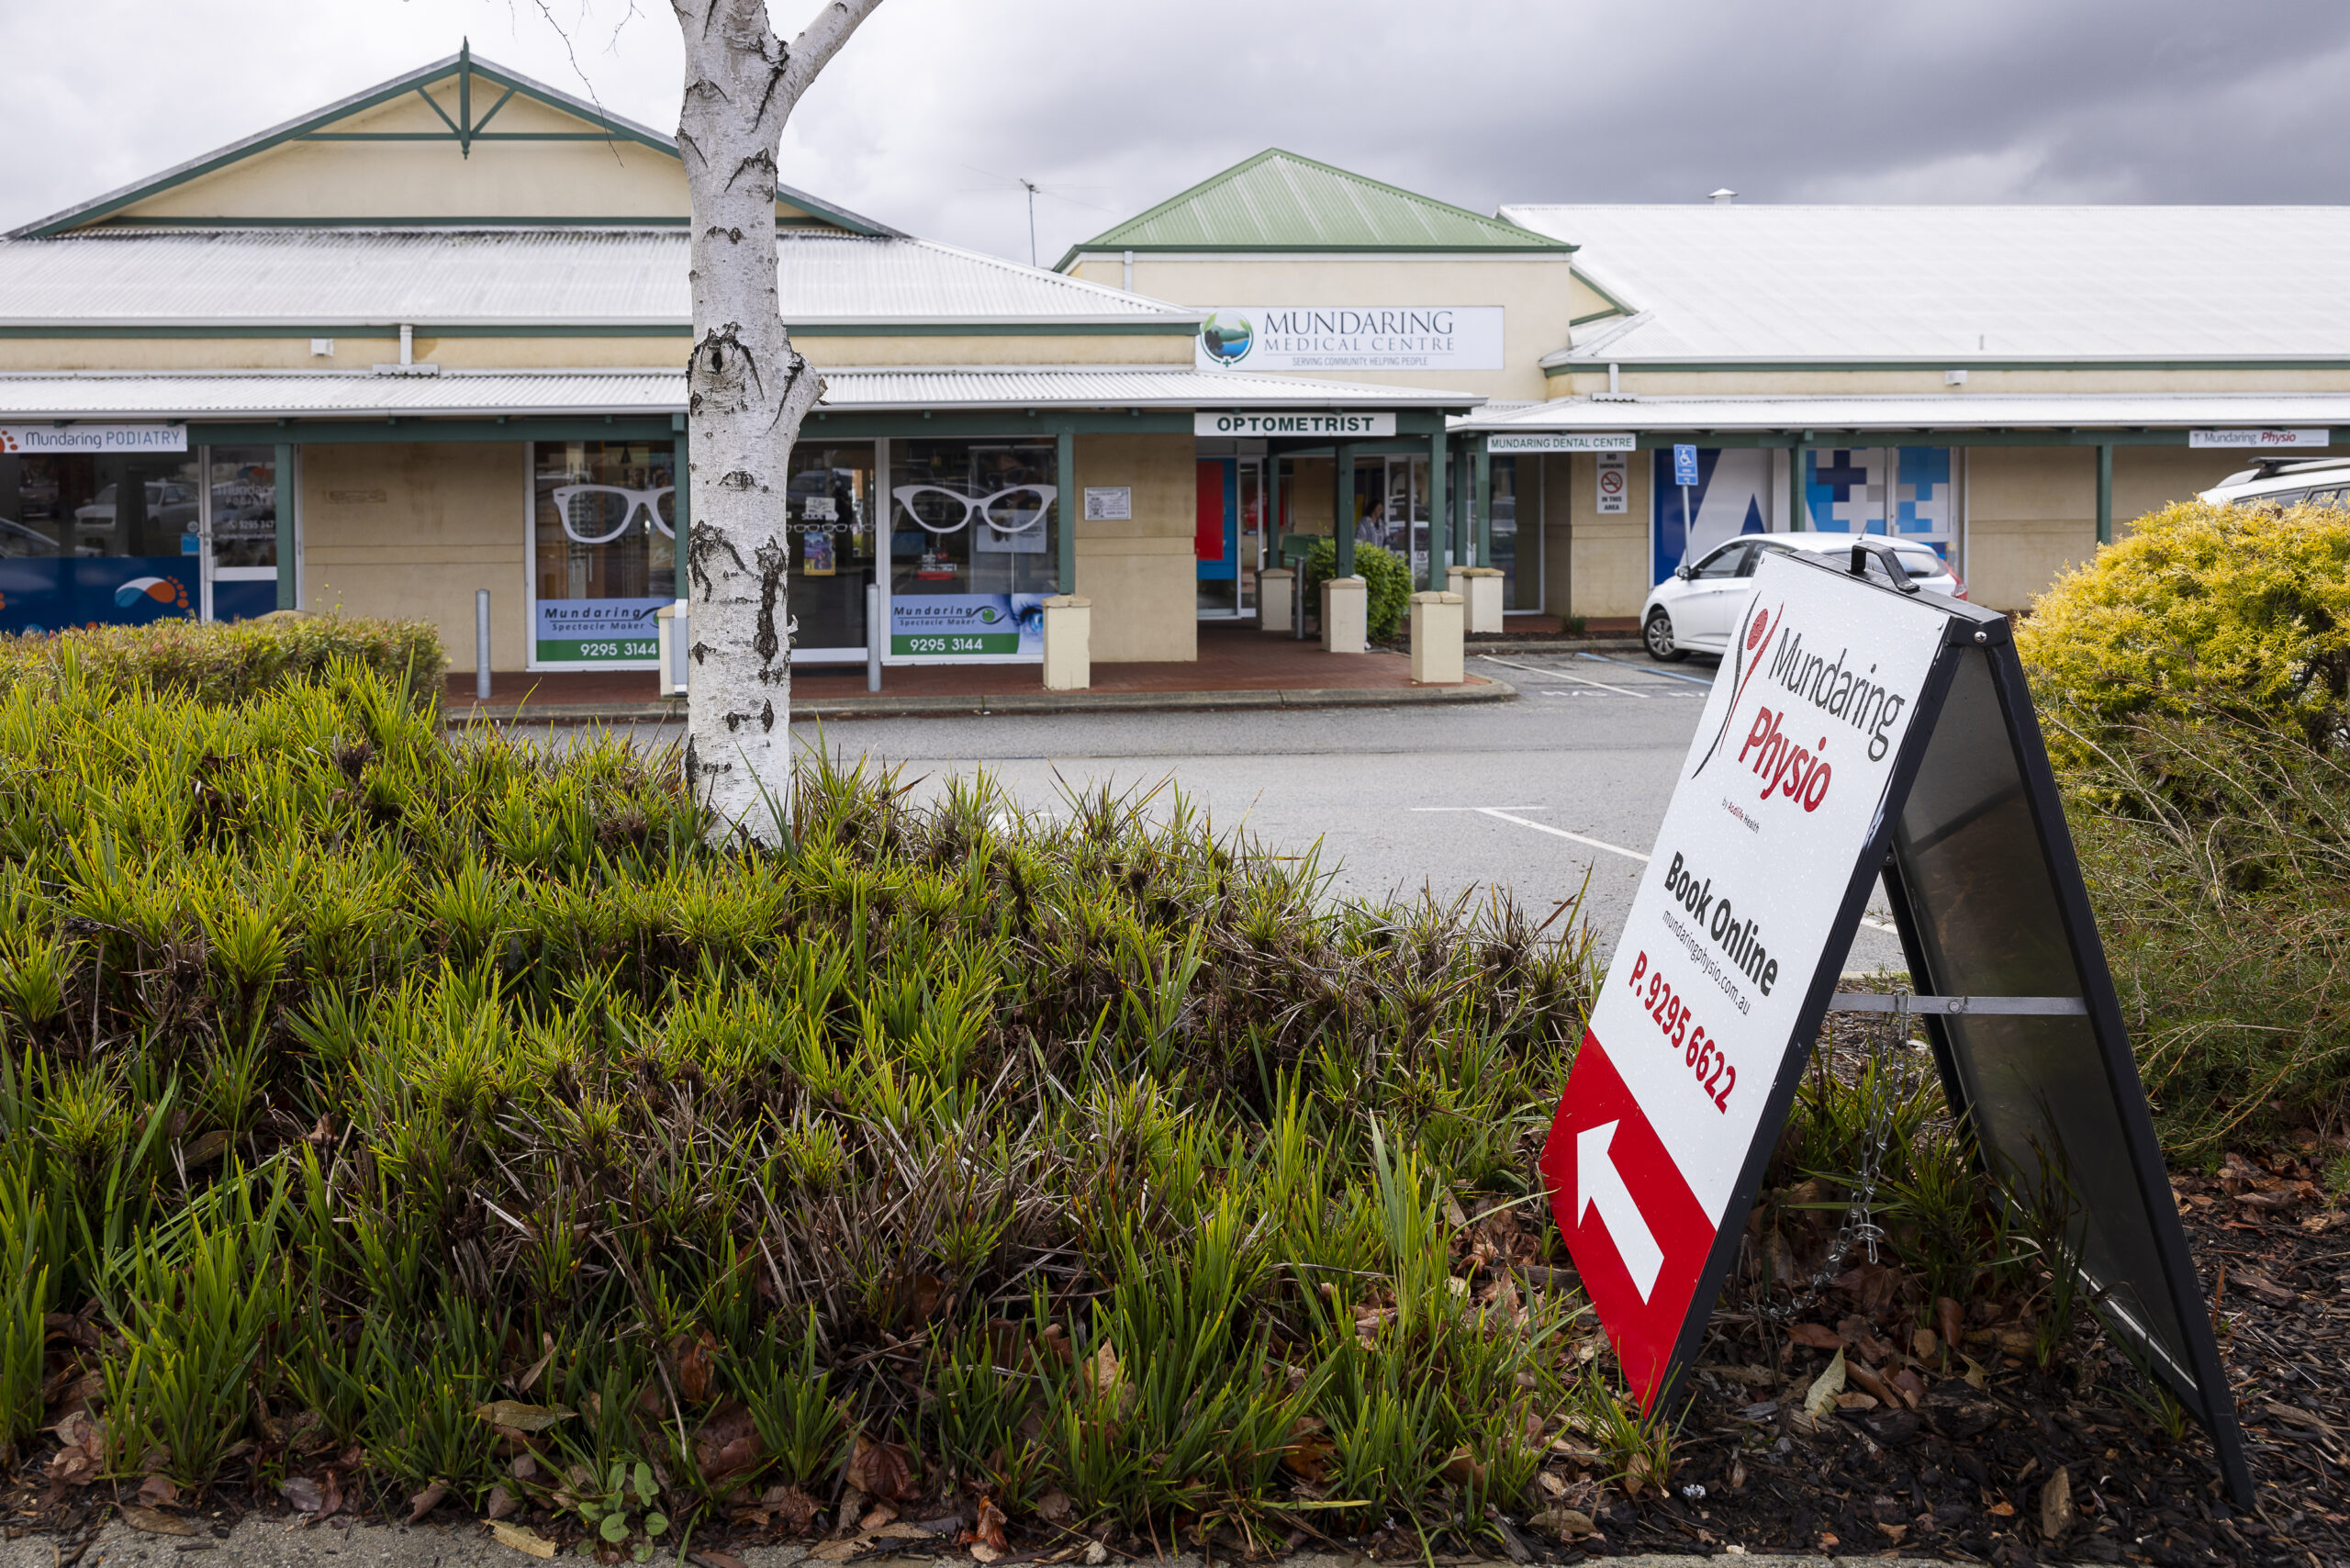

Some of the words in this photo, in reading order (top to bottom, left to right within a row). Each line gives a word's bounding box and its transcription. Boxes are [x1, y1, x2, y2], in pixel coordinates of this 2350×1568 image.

[1264, 310, 1453, 335] MUNDARING
[1264, 337, 1361, 352] MEDICAL
[1371, 337, 1453, 352] CENTRE
[1292, 356, 1322, 366] SERVING
[1370, 356, 1400, 366] HELPING
[1402, 356, 1427, 366] PEOPLE
[1216, 417, 1374, 431] OPTOMETRIST
[25, 431, 101, 449] Mundaring
[106, 431, 180, 445] PODIATRY
[1491, 438, 1550, 448] MUNDARING
[1553, 438, 1590, 448] DENTAL
[1594, 437, 1632, 448] CENTRE
[2204, 431, 2257, 445] Mundaring
[2261, 431, 2297, 444] Physio
[544, 607, 642, 621] Mundaring
[893, 605, 974, 618] Mundaring
[552, 622, 605, 632] Spectacle
[610, 622, 644, 630] Maker
[580, 644, 618, 656] 9295
[624, 643, 656, 655] 3144
[910, 639, 946, 651] 9295
[951, 638, 983, 651] 3144
[1768, 627, 1906, 762] Mundaring
[1738, 706, 1831, 812] Physio
[1722, 796, 1728, 810] by
[1743, 813, 1760, 834] Health
[1664, 851, 1714, 927] Book
[1711, 899, 1778, 997] Online
[1662, 909, 1751, 1016] mundaringphysio.com.au
[1628, 950, 1648, 997] P.
[1644, 972, 1691, 1048] 9295
[1685, 1025, 1736, 1114] 6622
